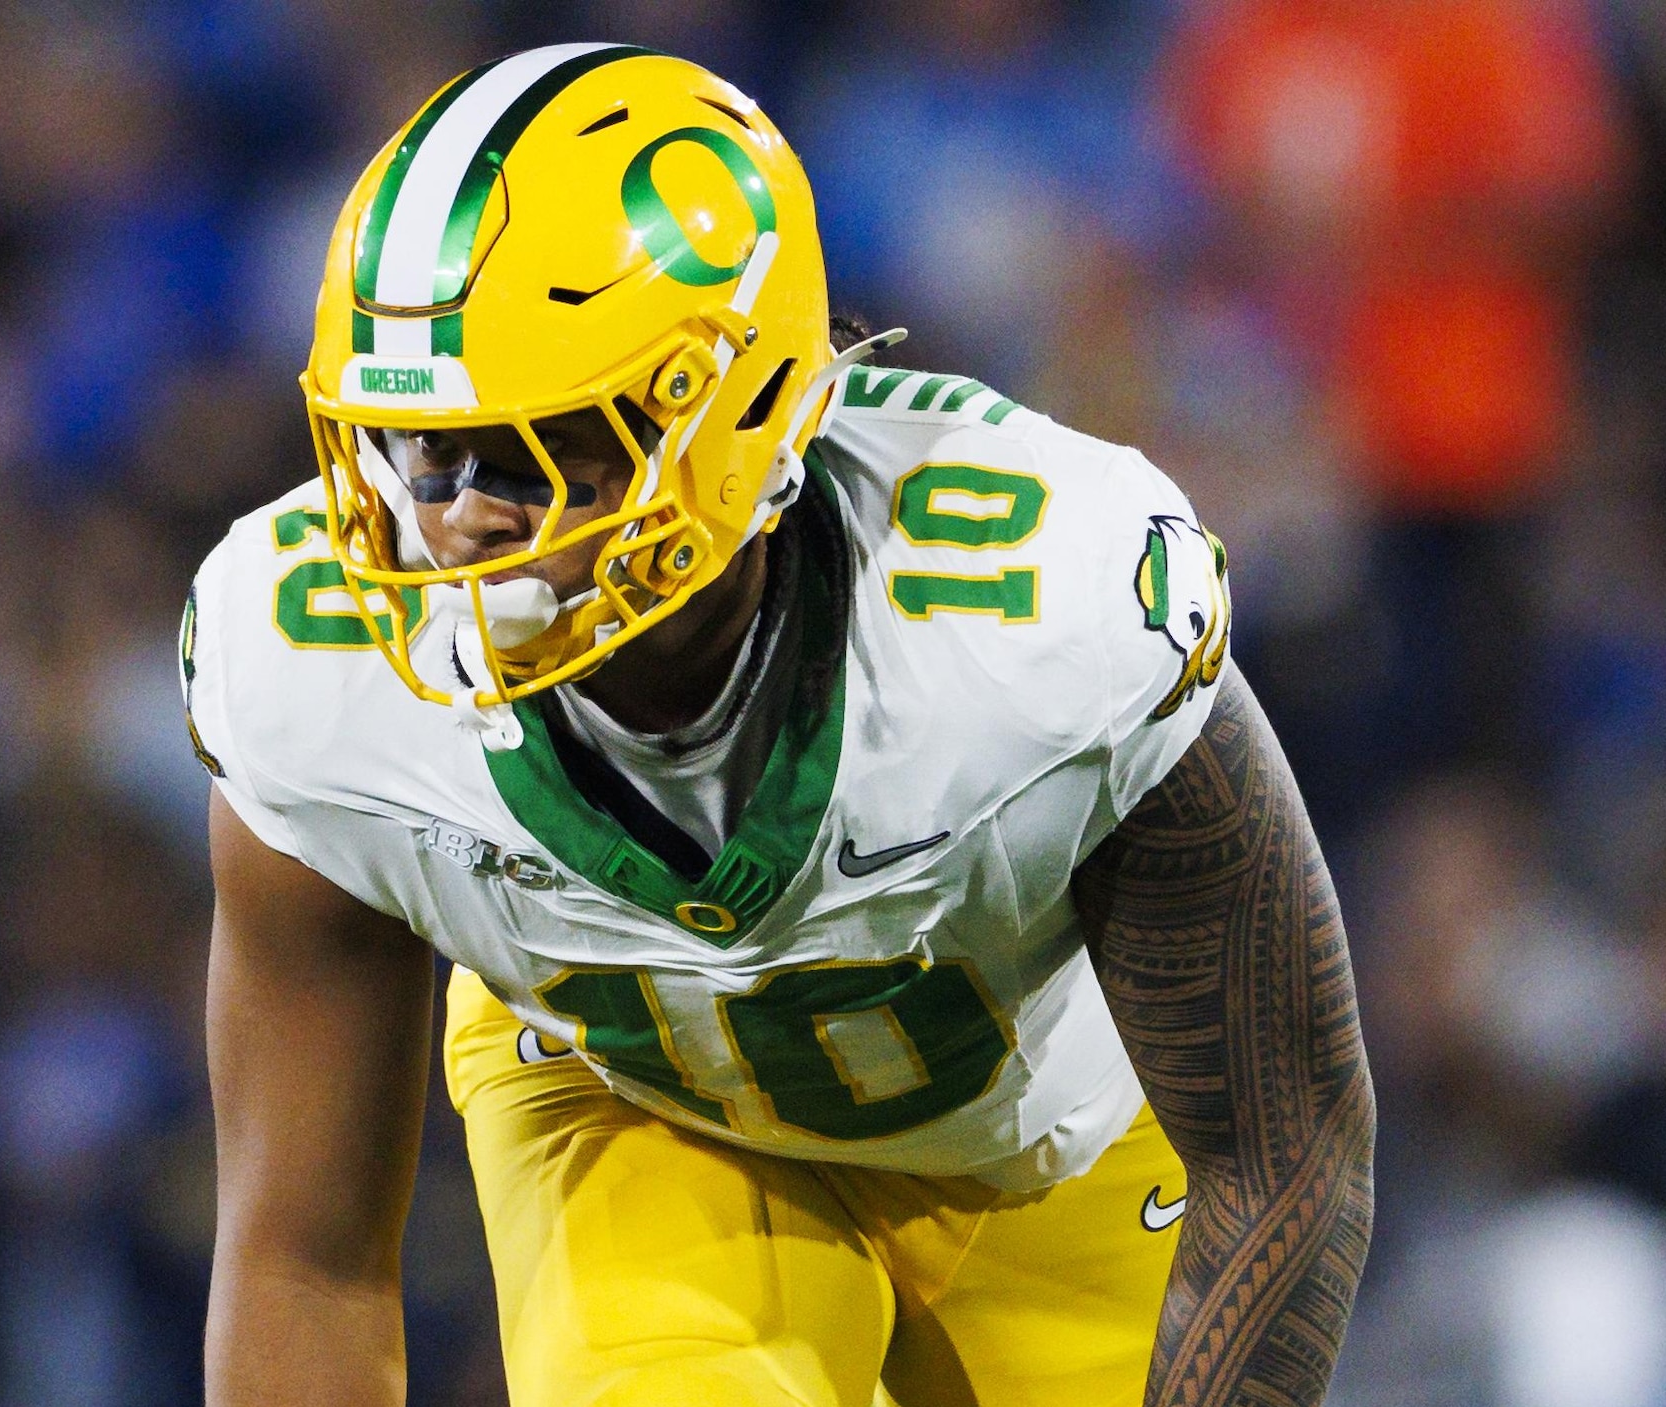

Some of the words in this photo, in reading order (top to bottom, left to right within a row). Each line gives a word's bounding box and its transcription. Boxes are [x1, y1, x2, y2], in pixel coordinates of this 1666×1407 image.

[360, 367, 435, 395] OREGON
[888, 461, 1053, 625] 10
[533, 957, 1018, 1142] 10
